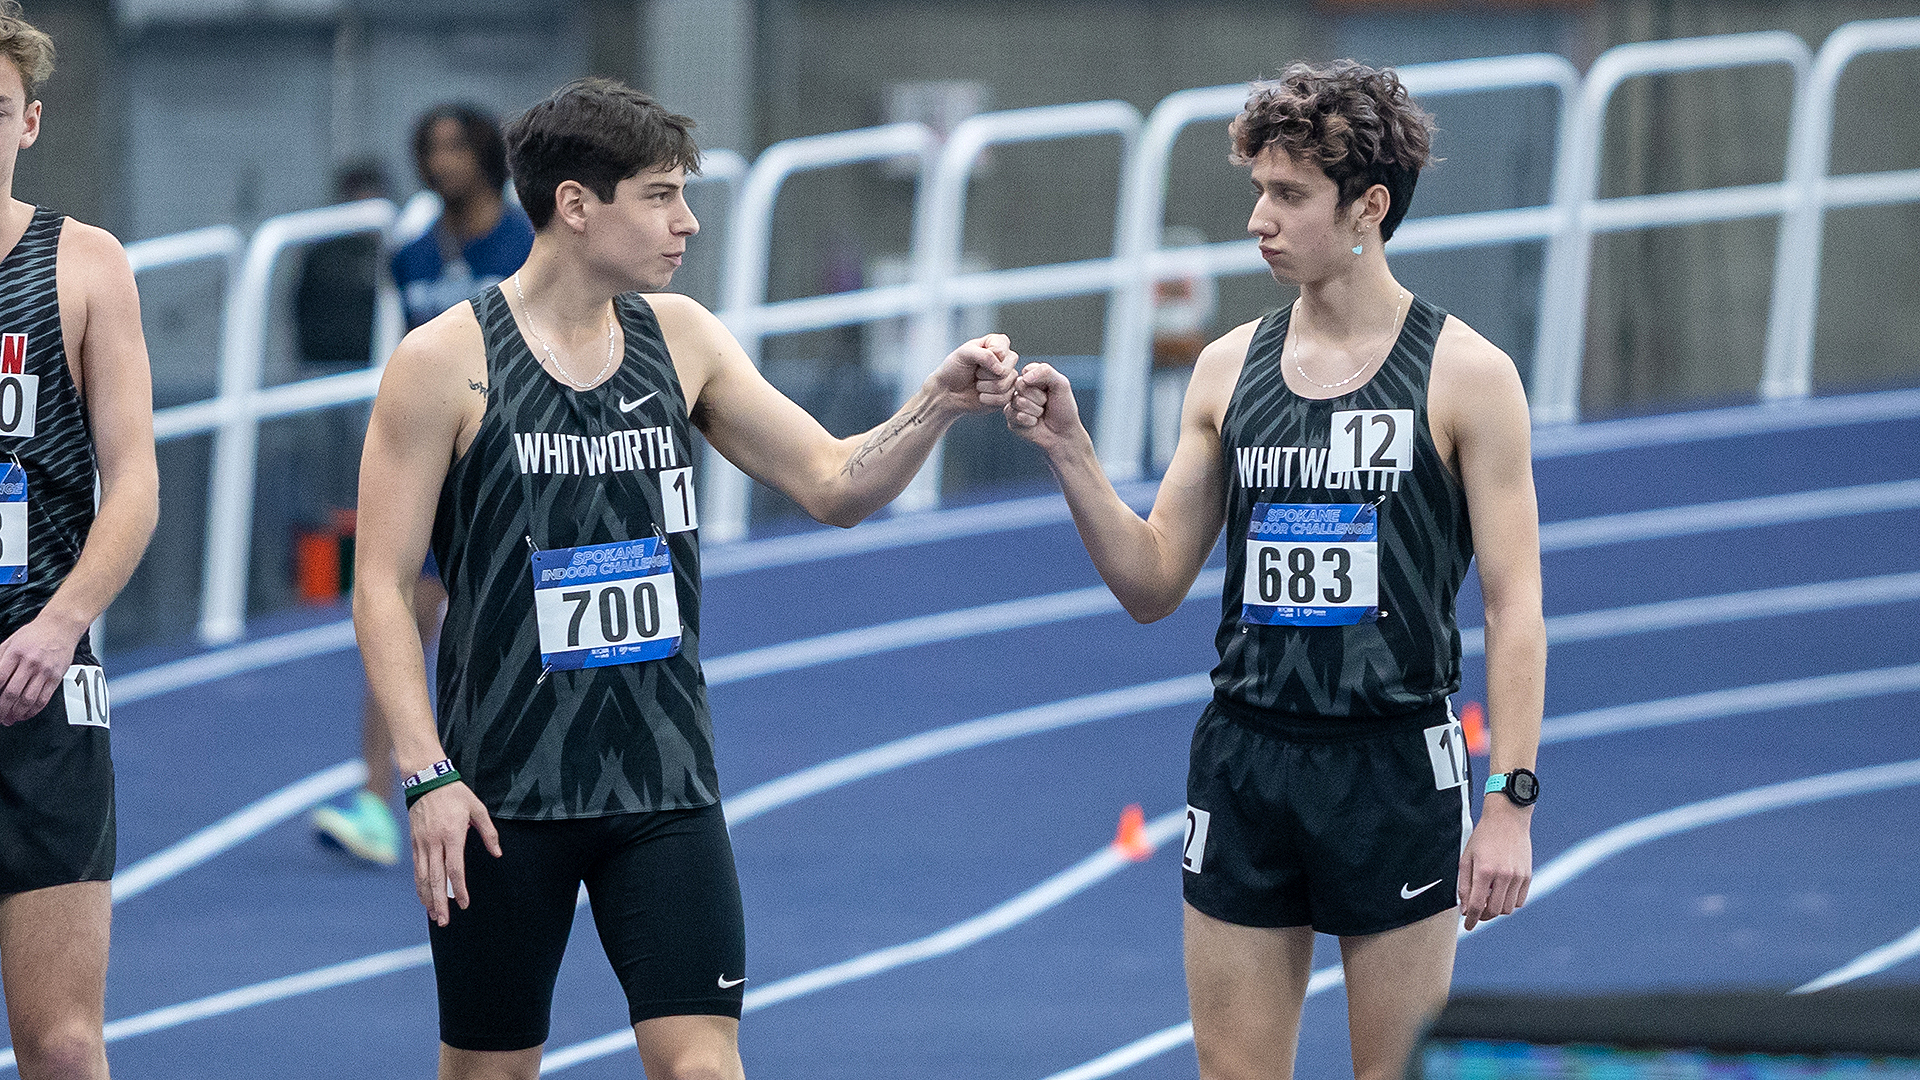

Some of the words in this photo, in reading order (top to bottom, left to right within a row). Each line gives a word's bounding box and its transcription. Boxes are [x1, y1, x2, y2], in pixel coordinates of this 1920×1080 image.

[514, 426, 677, 477] WHITWORTH
[1344, 414, 1398, 468] 12
[1267, 508, 1342, 523] SPOKANE
[1290, 522, 1375, 535] CHALLENGE
[541, 563, 598, 582] INDOOR
[600, 553, 670, 575] CHALLENGE
[572, 543, 645, 566] SPOKANE
[1258, 546, 1353, 604] 683
[562, 582, 661, 648] 700
[74, 668, 108, 725] 10
